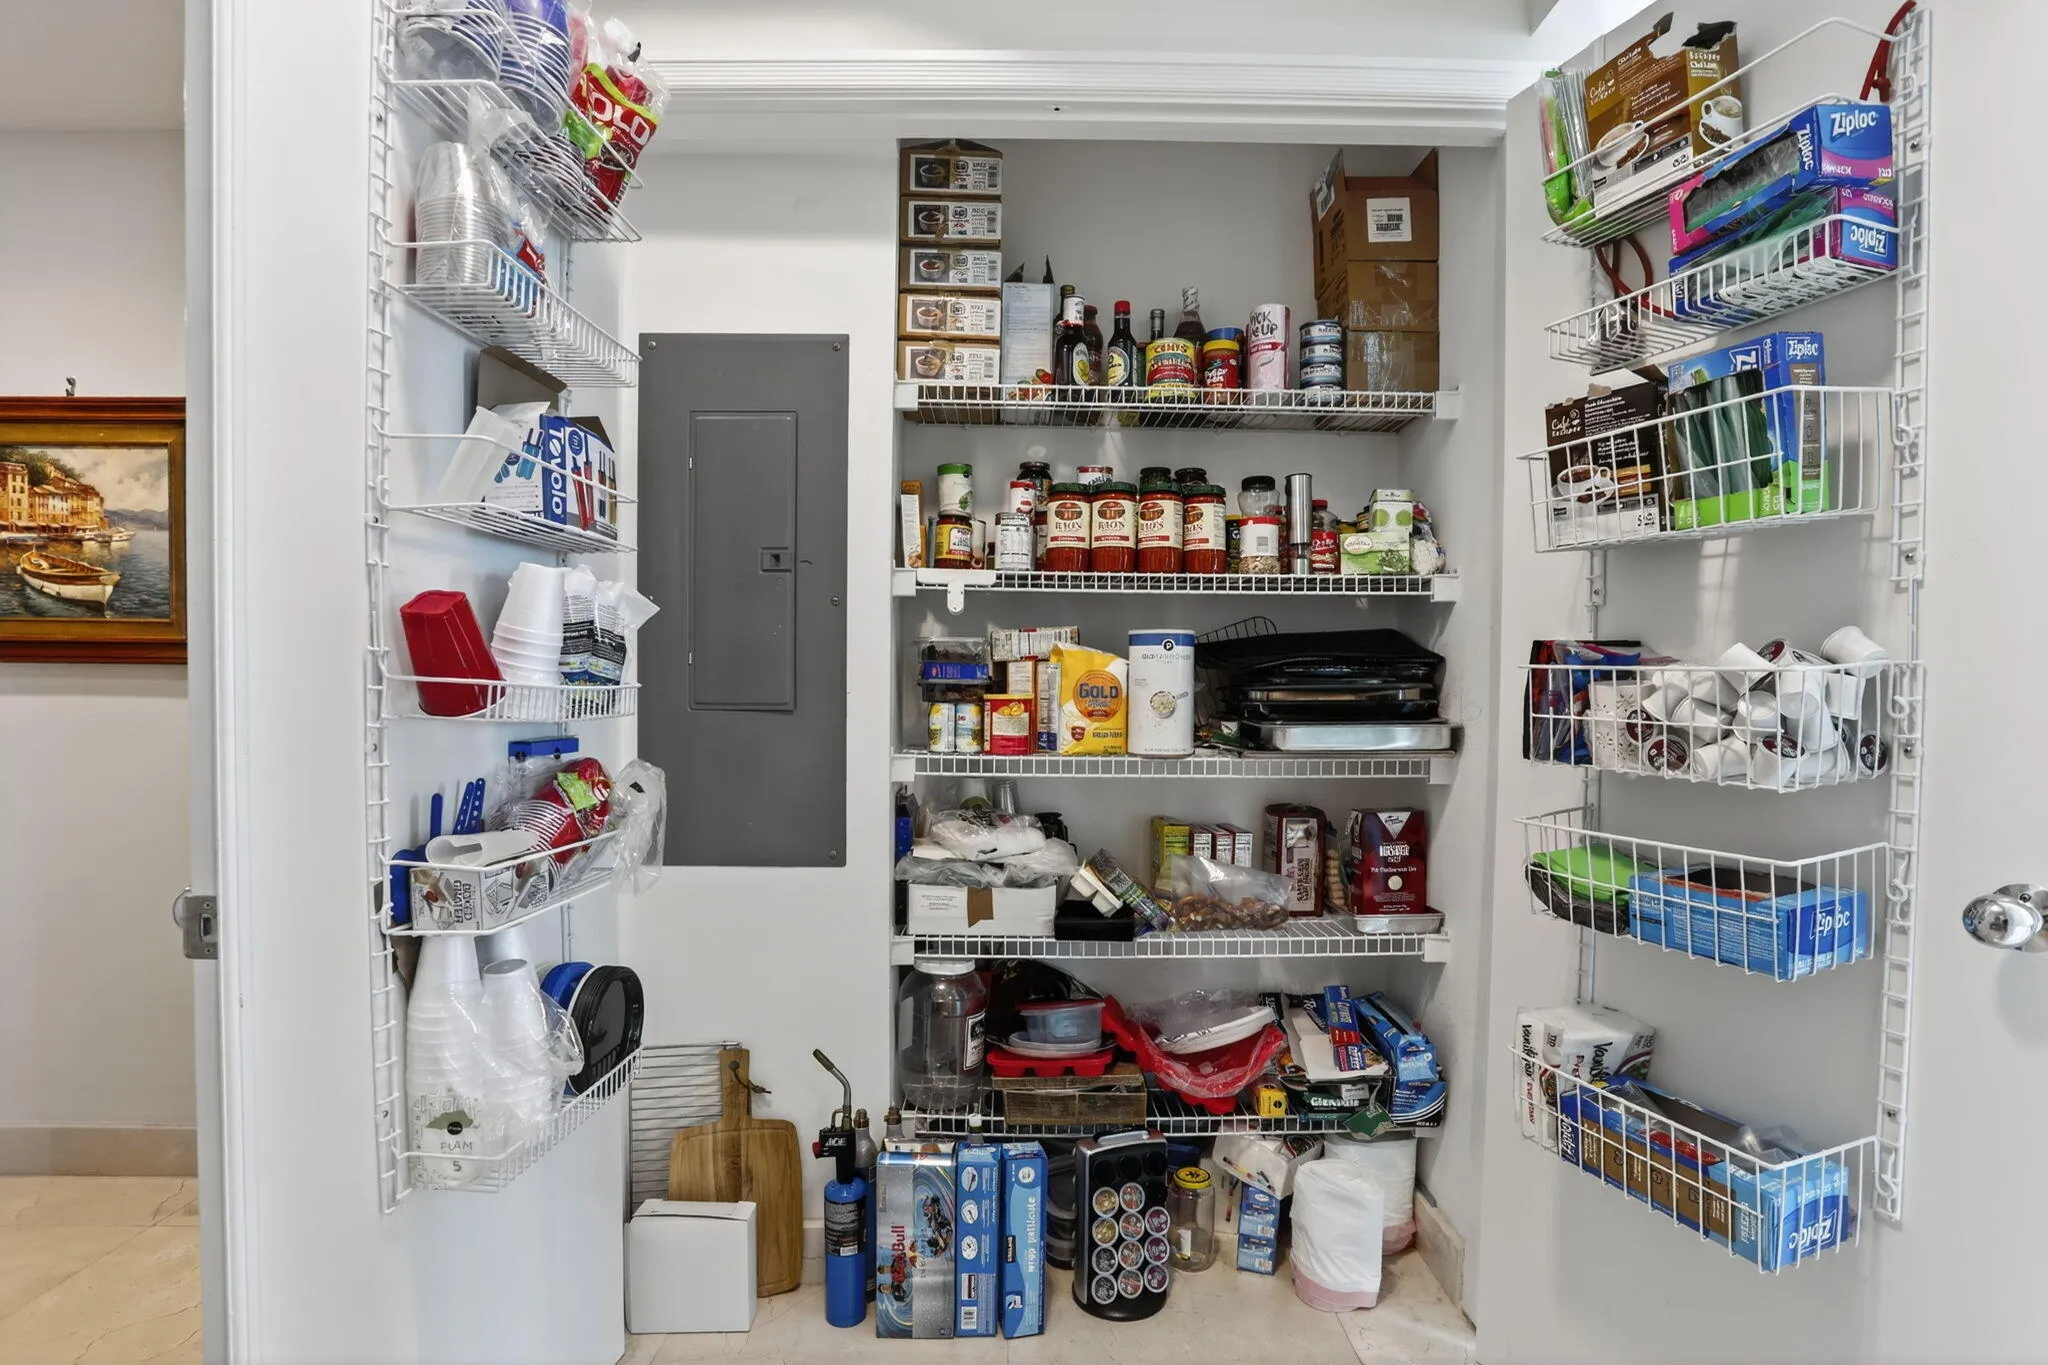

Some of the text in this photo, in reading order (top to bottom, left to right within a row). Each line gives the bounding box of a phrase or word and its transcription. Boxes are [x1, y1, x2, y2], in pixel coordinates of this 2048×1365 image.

[1830, 109, 1877, 137] Ziploc
[1796, 123, 1814, 171] Ziploc
[1851, 224, 1886, 254] Ziploc
[1261, 323, 1278, 336] UP
[1787, 339, 1819, 360] Ziploc
[1078, 682, 1119, 699] GOLD
[1816, 909, 1851, 937] Zipoc
[890, 1225, 906, 1253] Bull
